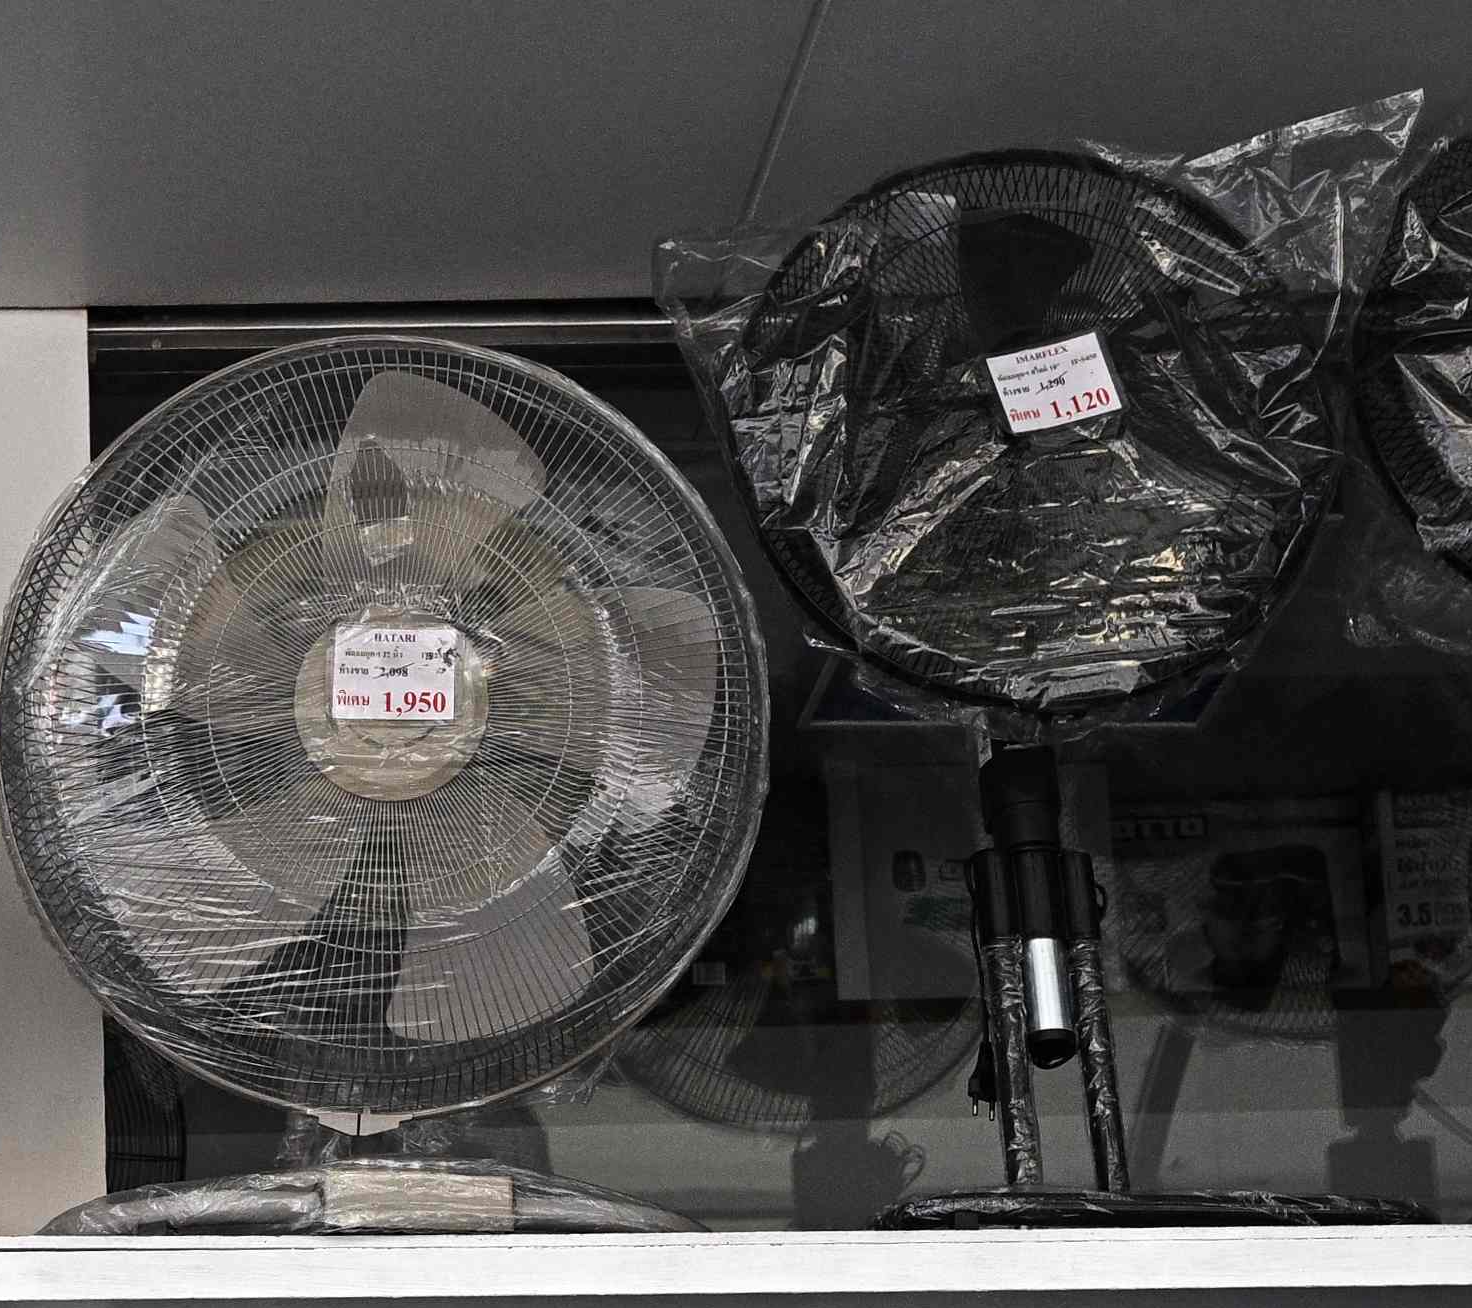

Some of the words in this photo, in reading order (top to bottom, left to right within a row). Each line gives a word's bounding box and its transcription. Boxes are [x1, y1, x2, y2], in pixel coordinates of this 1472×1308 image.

[1016, 345, 1068, 364] IMARFLEX
[1010, 408, 1041, 422] พิเศษ
[1050, 387, 1110, 420] 1,120
[374, 633, 417, 642] HATARI
[338, 689, 370, 707] พิเศษ
[382, 691, 447, 717] 1,950
